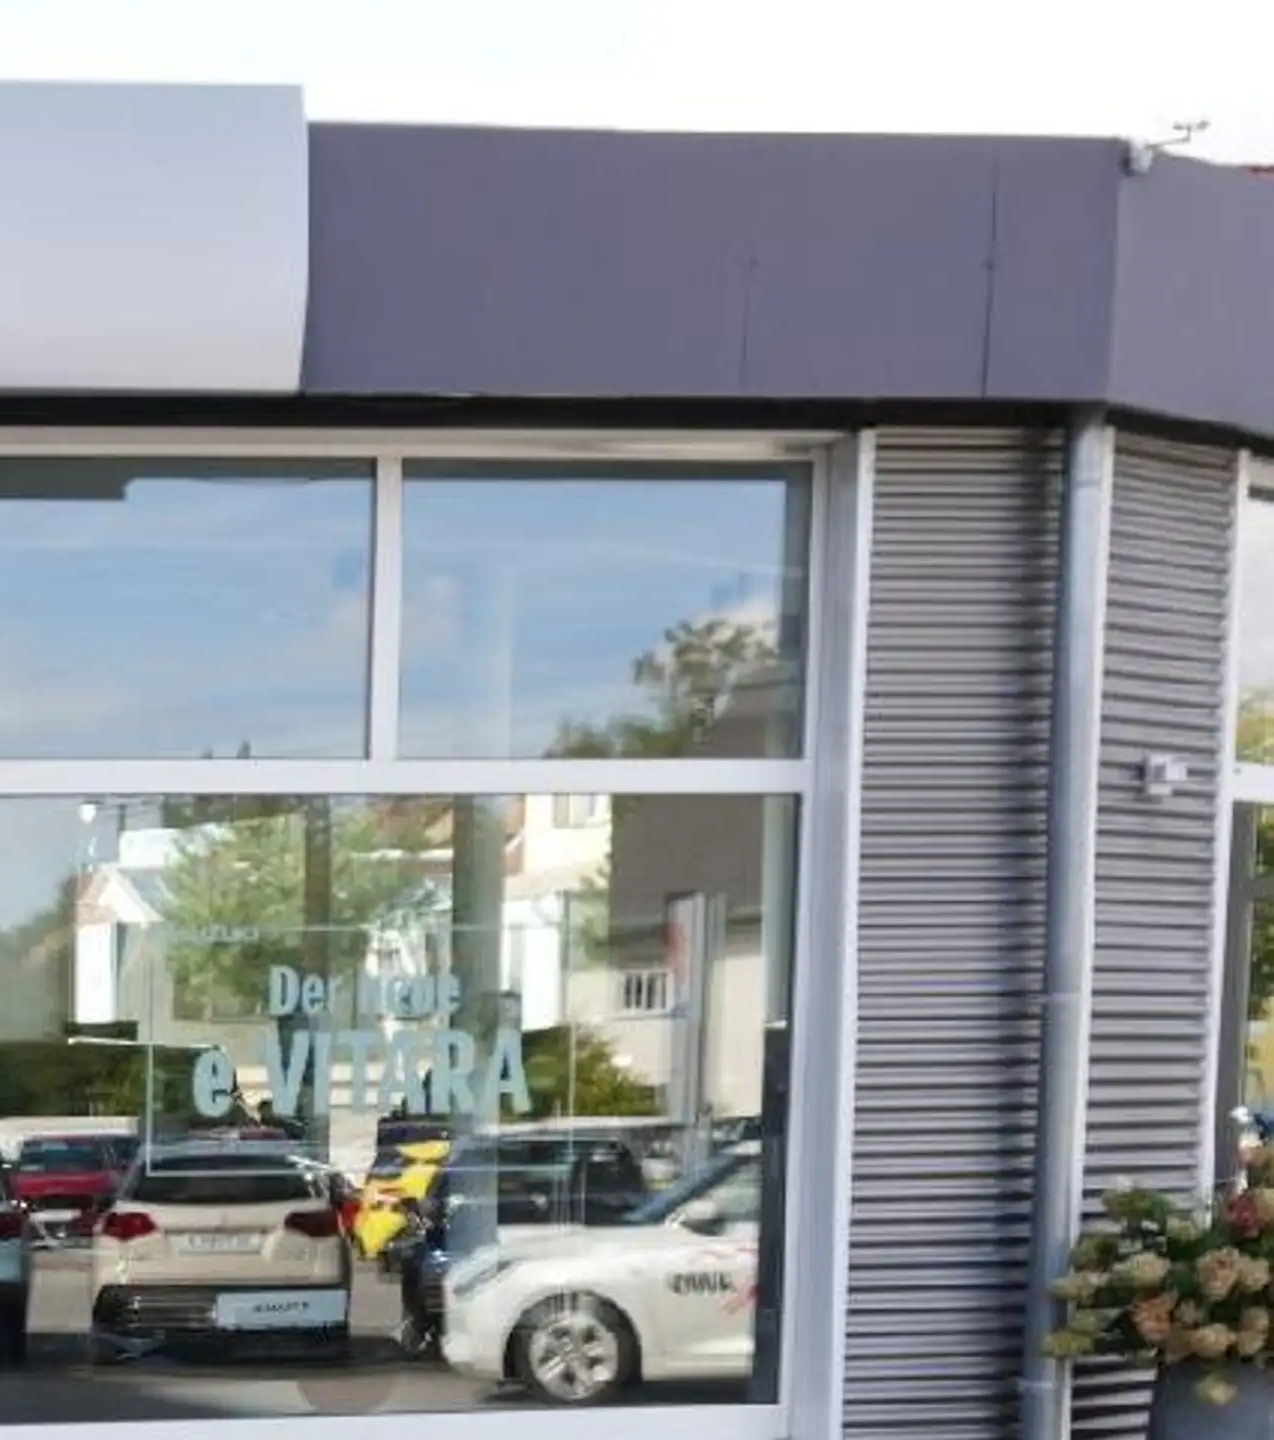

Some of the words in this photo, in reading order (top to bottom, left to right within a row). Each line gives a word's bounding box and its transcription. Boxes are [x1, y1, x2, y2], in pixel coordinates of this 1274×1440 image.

[269, 964, 342, 1016] Der
[193, 1048, 236, 1118] e
[264, 1028, 532, 1117] VITARA
